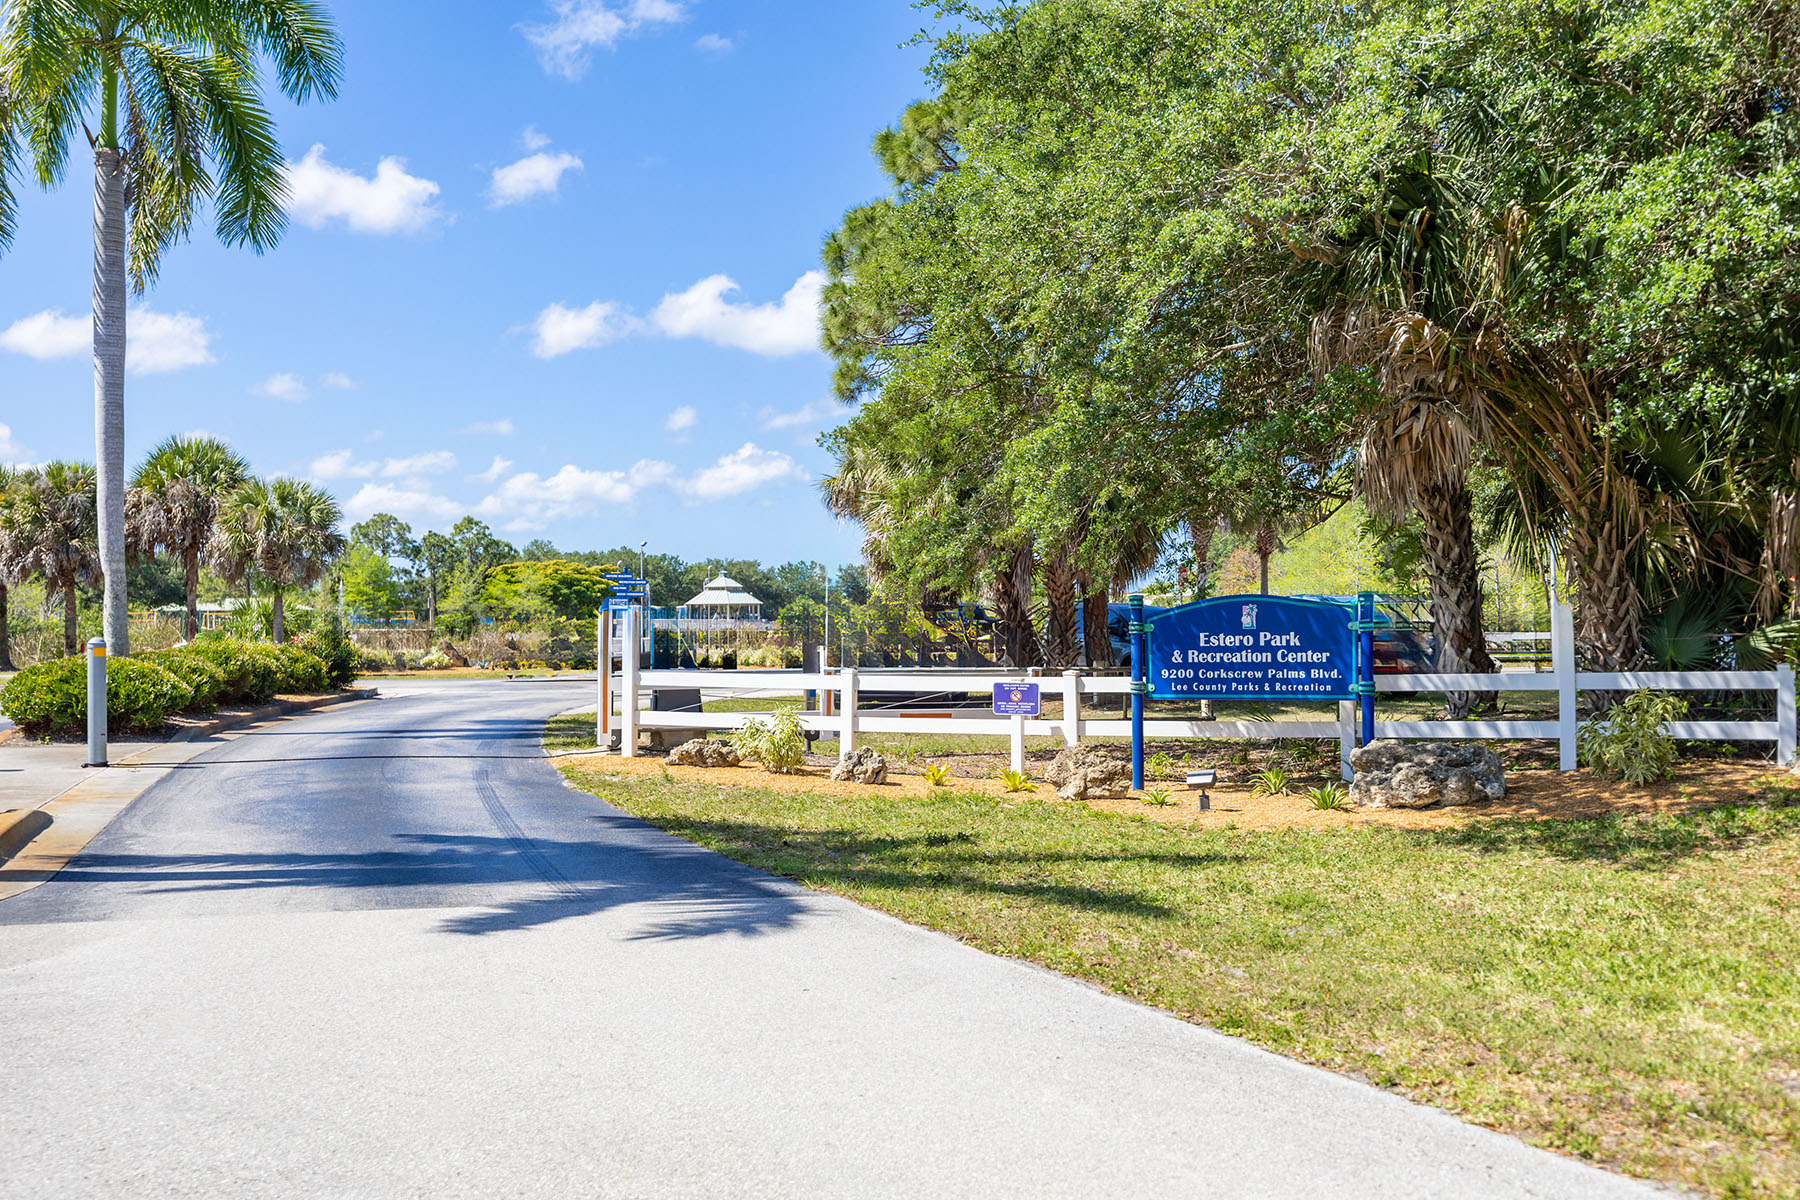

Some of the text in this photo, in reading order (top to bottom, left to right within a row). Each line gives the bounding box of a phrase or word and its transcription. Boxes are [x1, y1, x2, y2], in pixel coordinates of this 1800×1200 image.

[1200, 632, 1300, 646] Estero Park
[1172, 649, 1330, 663] & Recreation Center
[1162, 669, 1341, 678] 9200 Corkscrew Palms Blvd.
[1193, 683, 1226, 692] County
[1232, 682, 1258, 690] Parks
[1276, 683, 1331, 691] Recreation
